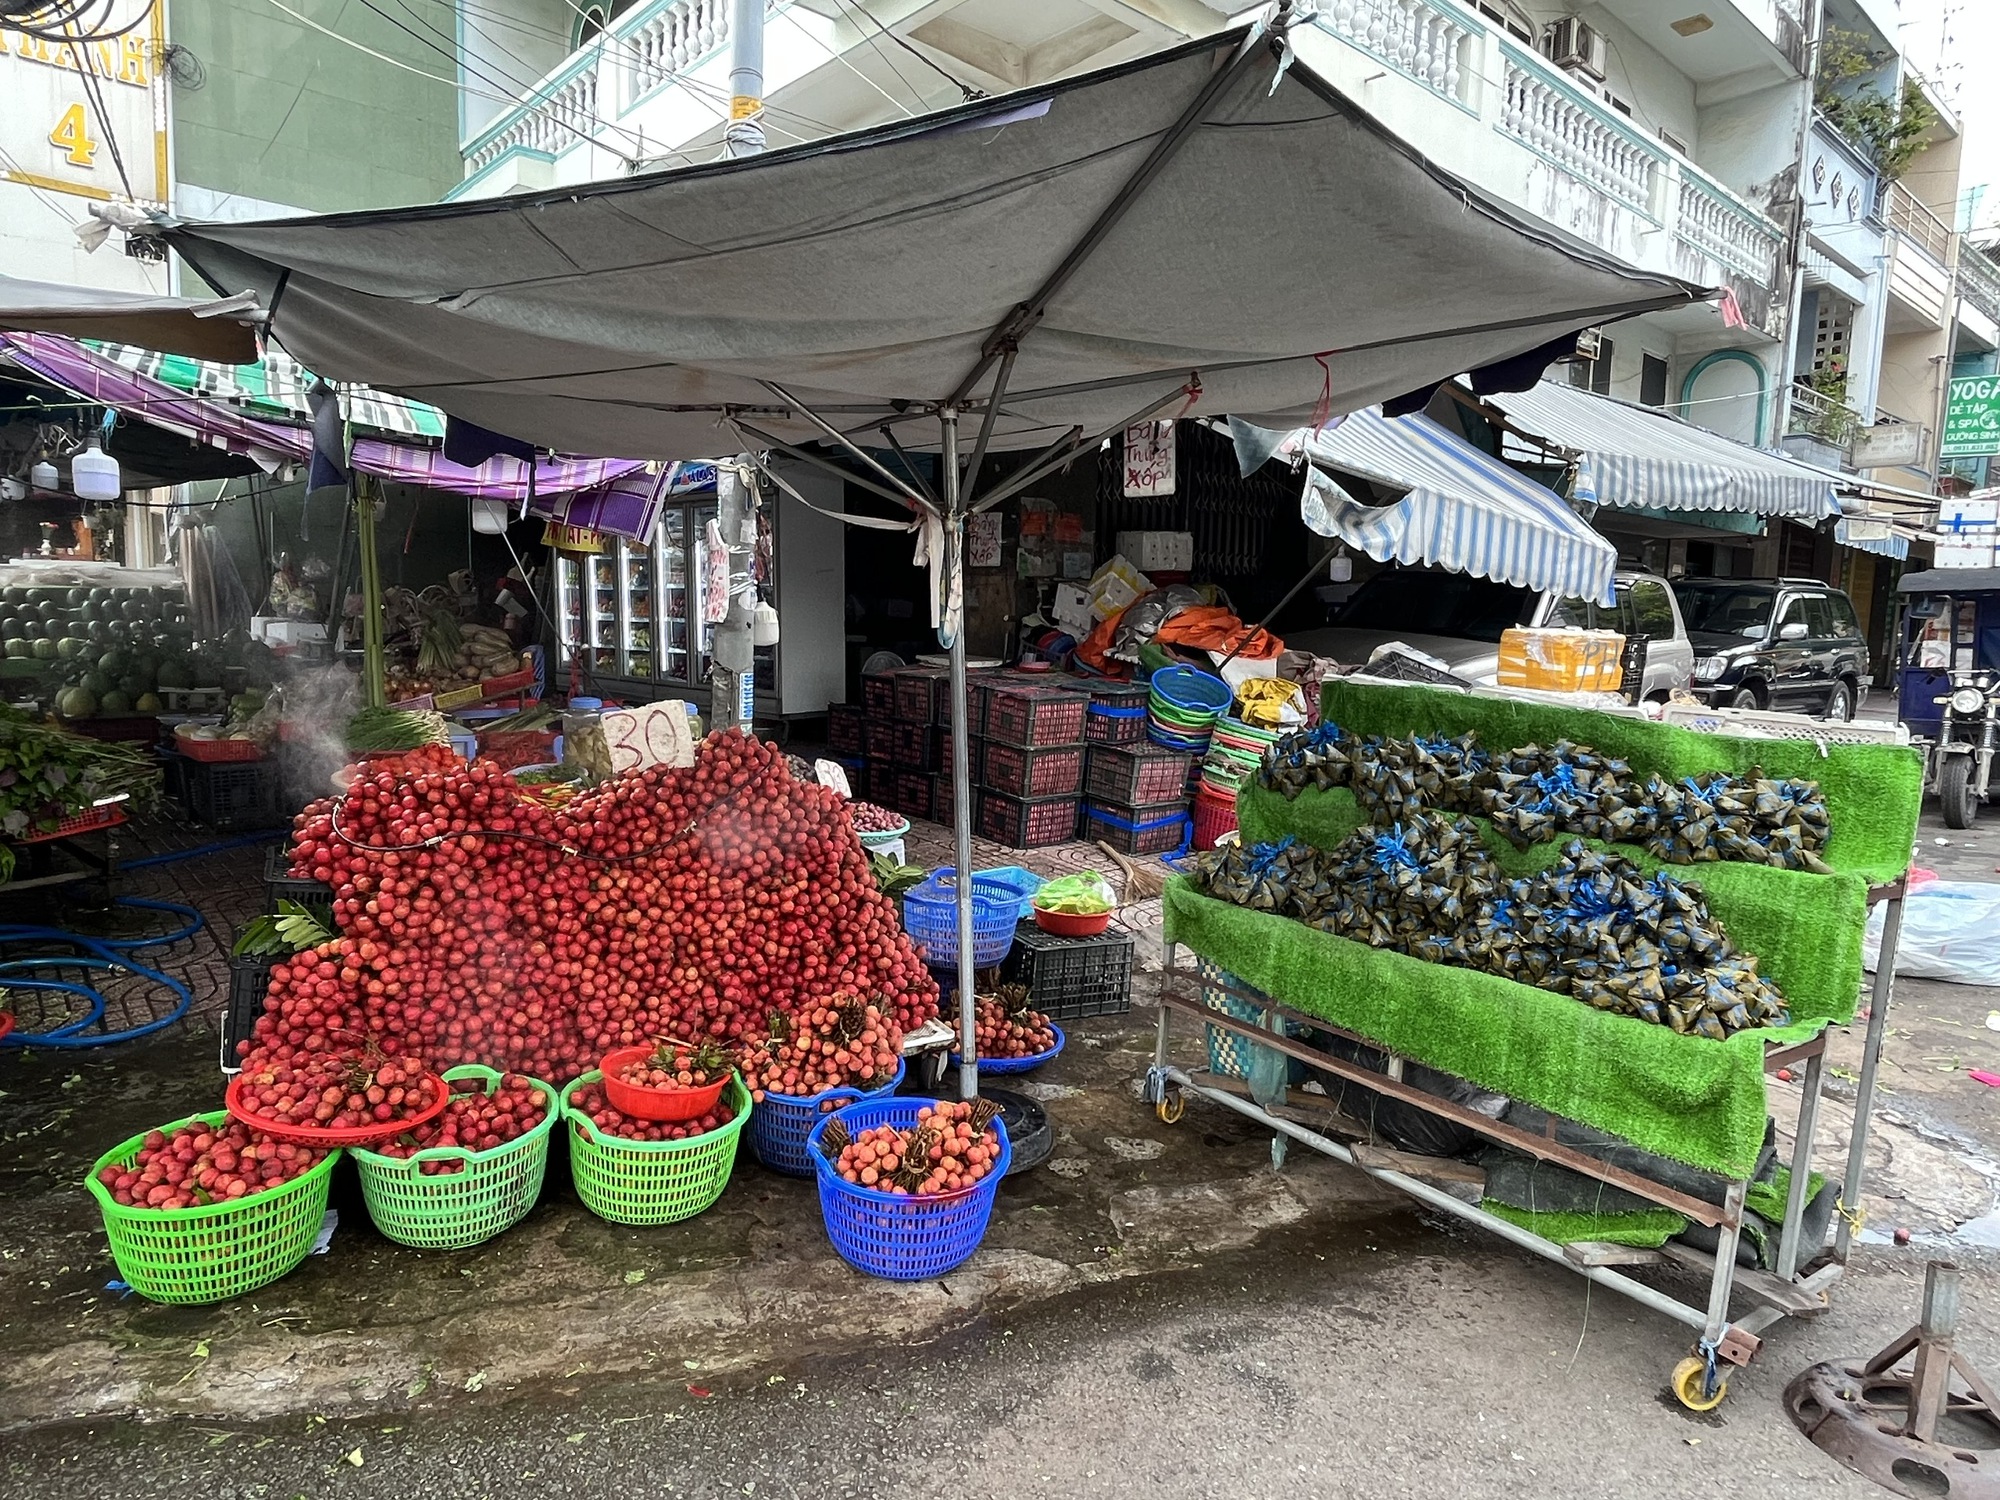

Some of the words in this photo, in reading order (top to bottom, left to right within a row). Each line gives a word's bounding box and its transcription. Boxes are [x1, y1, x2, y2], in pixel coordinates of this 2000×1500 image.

[51, 104, 97, 165] 4
[1957, 418, 1979, 429] SPA
[605, 710, 679, 773] 30
